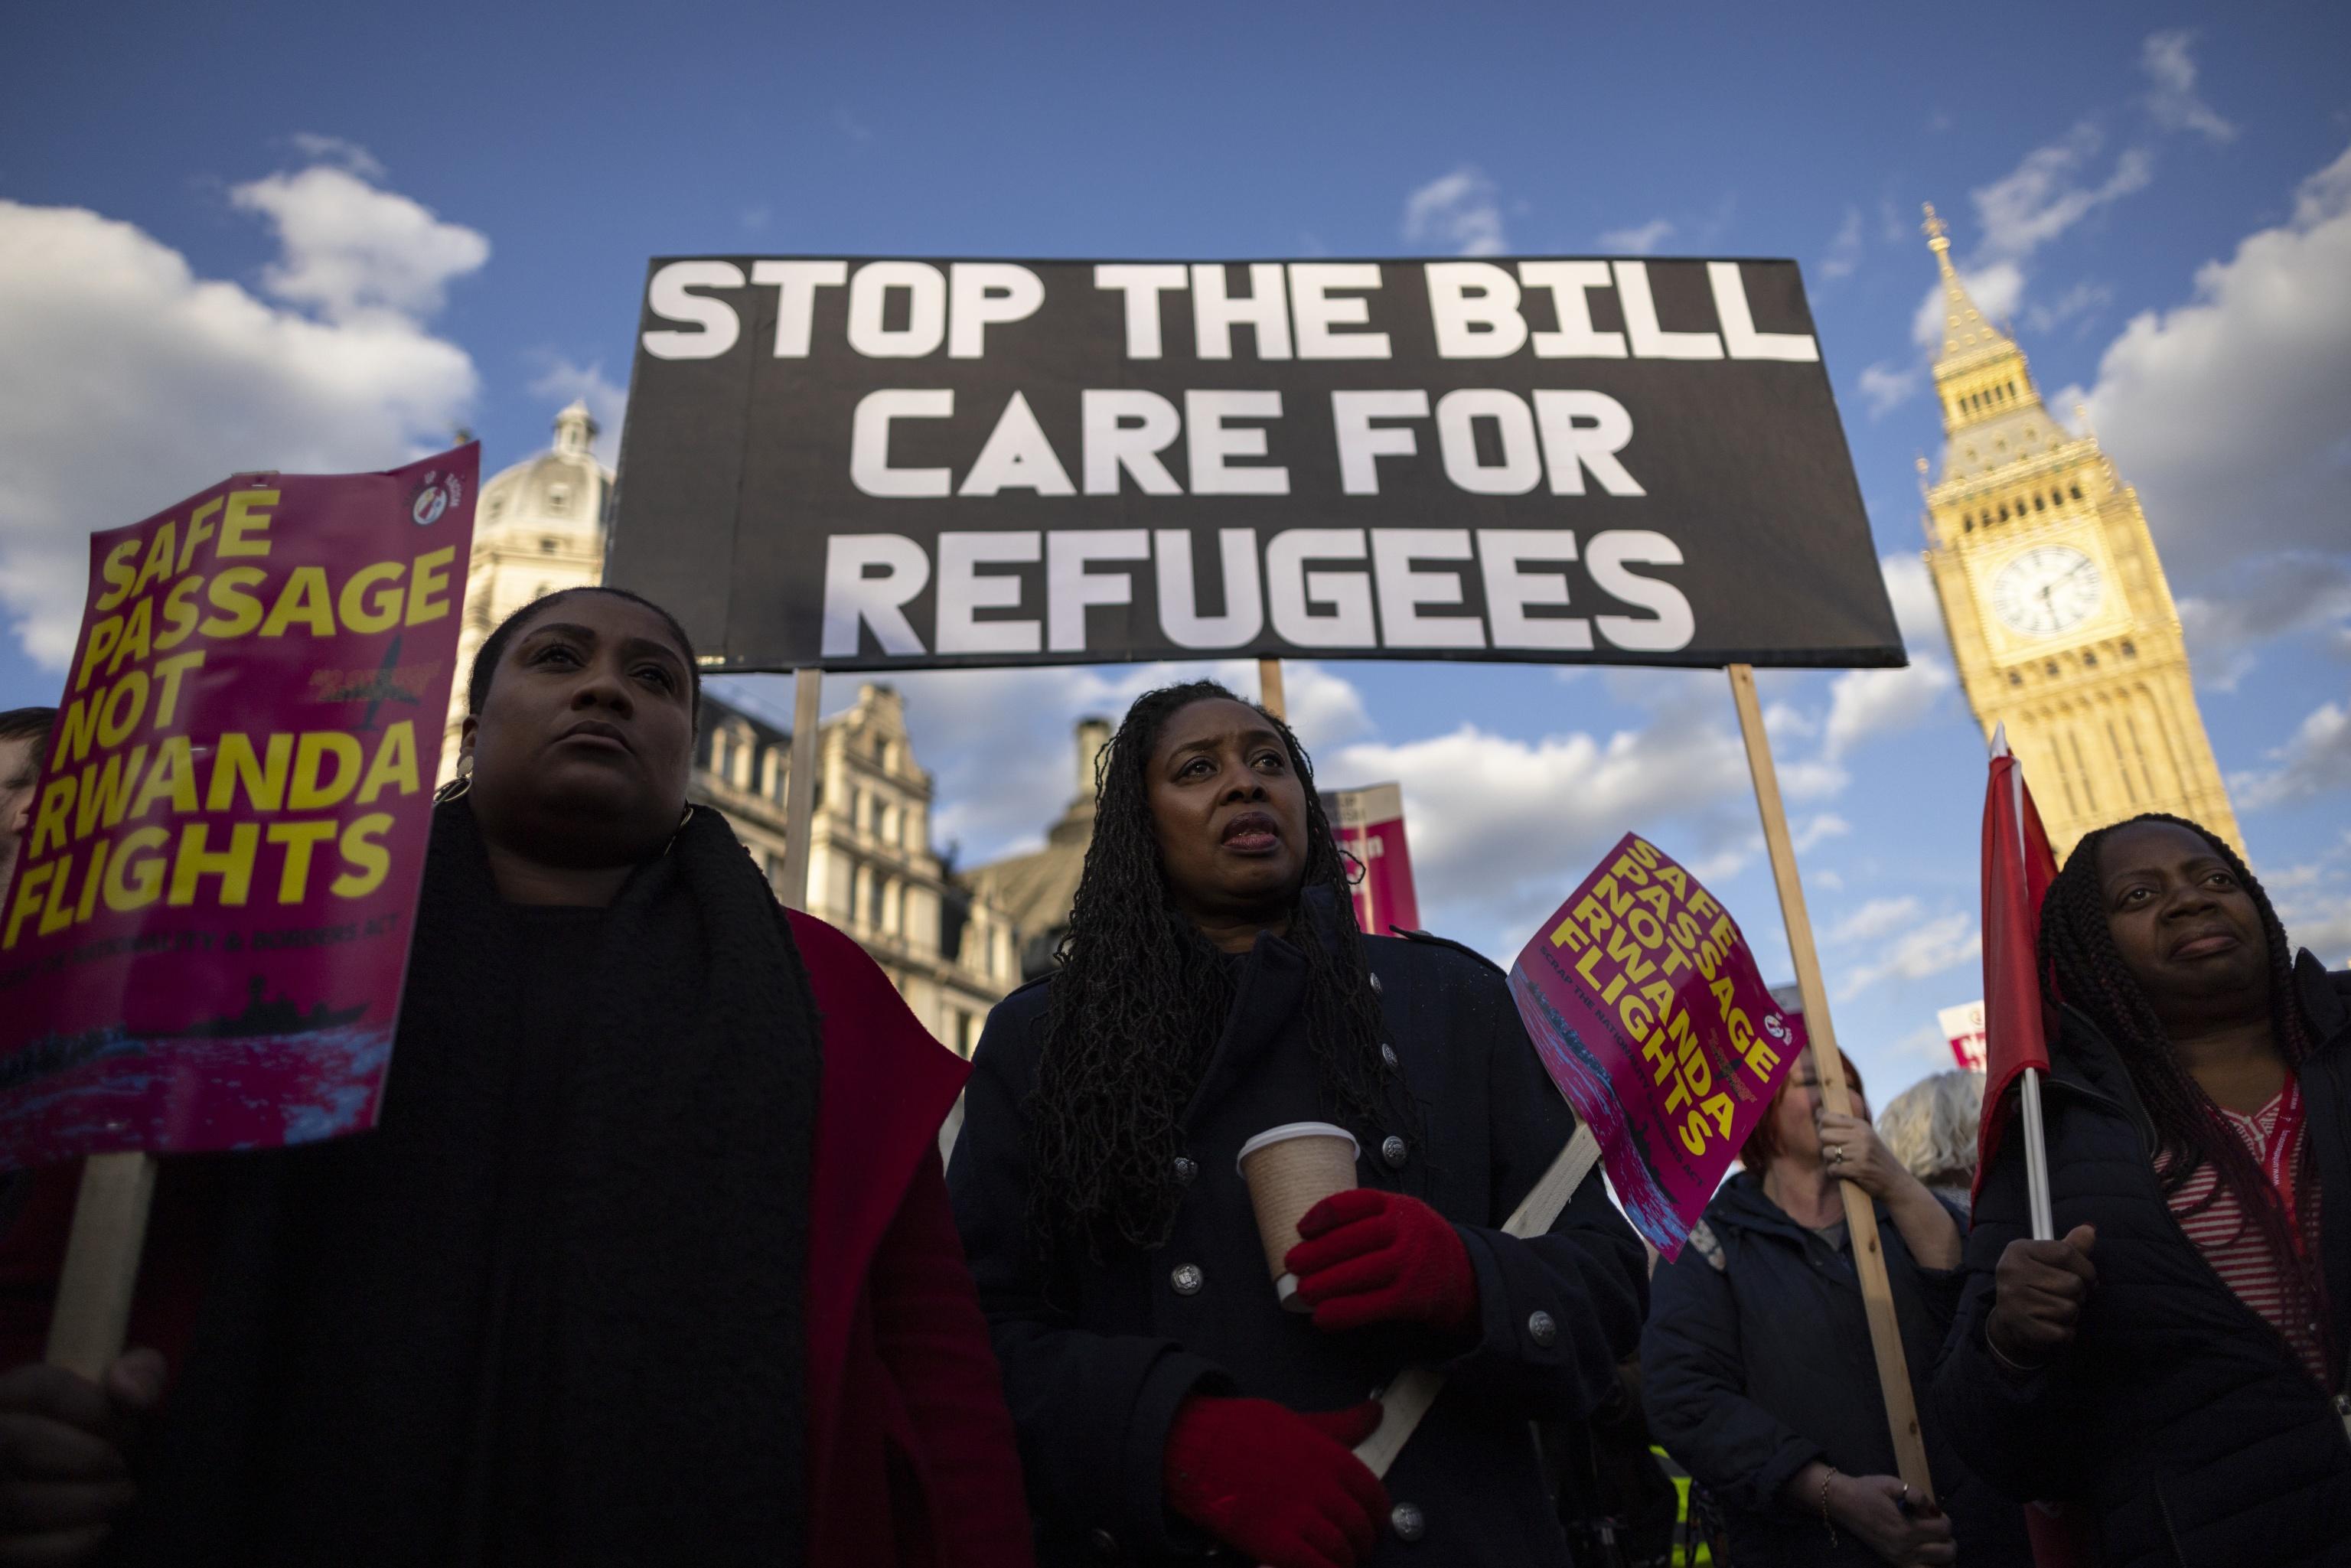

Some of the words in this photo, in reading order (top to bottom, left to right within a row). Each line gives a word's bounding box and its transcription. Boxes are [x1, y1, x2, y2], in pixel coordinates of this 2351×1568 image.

[642, 260, 1045, 360] STOP
[1094, 263, 1393, 360] THE
[1423, 260, 1821, 363] BILL
[850, 388, 1292, 497] CARE
[1331, 388, 1648, 497] FOR
[95, 490, 281, 610] SAFE
[821, 528, 1697, 657] REFUGEES
[77, 546, 456, 693] PASSAGE
[51, 650, 206, 773] NOT
[28, 720, 421, 859] RWANDA
[3, 813, 395, 950] FLIGHTS
[1593, 873, 1692, 976] NOT
[1629, 838, 1738, 957] SAFE
[1540, 946, 1573, 984] SCRAP
[1574, 986, 1595, 1009] THE
[1596, 1009, 1650, 1088] NATIONALITY
[1573, 895, 1735, 1141] RWANDA
[1611, 854, 1781, 1084] PASSAGE
[1550, 918, 1713, 1156] FLIGHTS
